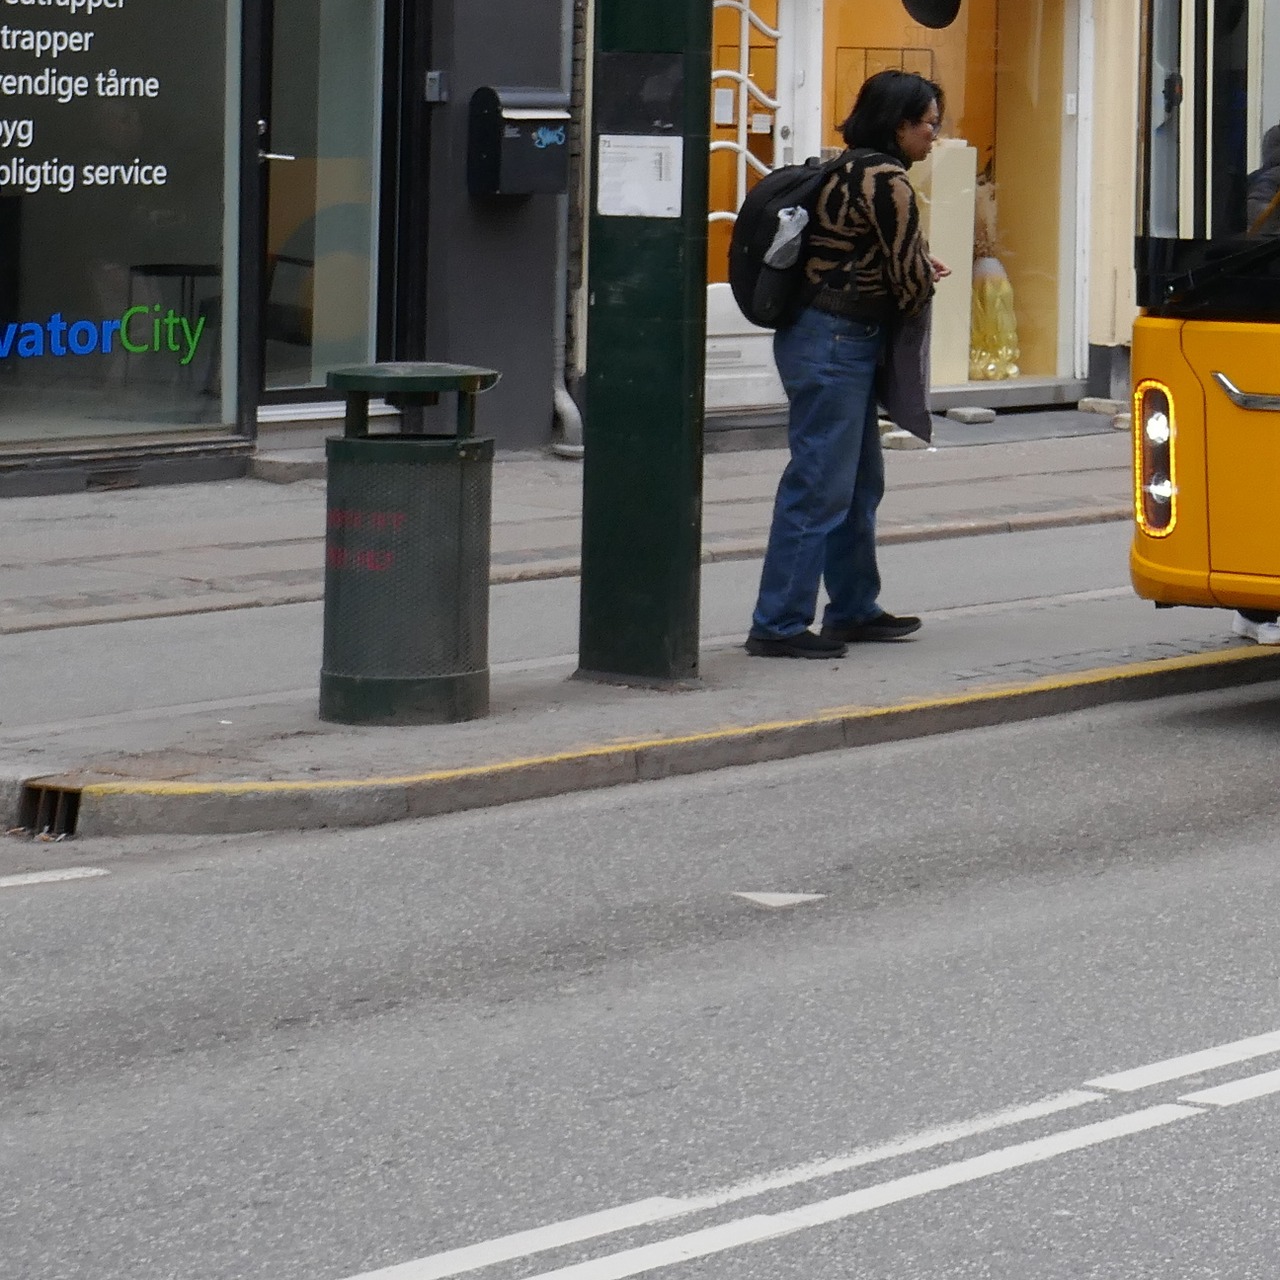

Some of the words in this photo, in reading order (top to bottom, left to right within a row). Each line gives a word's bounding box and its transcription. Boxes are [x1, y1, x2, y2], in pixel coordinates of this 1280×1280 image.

[0, 25, 94, 58] trapper
[95, 68, 160, 97] tårne
[82, 158, 167, 185] service
